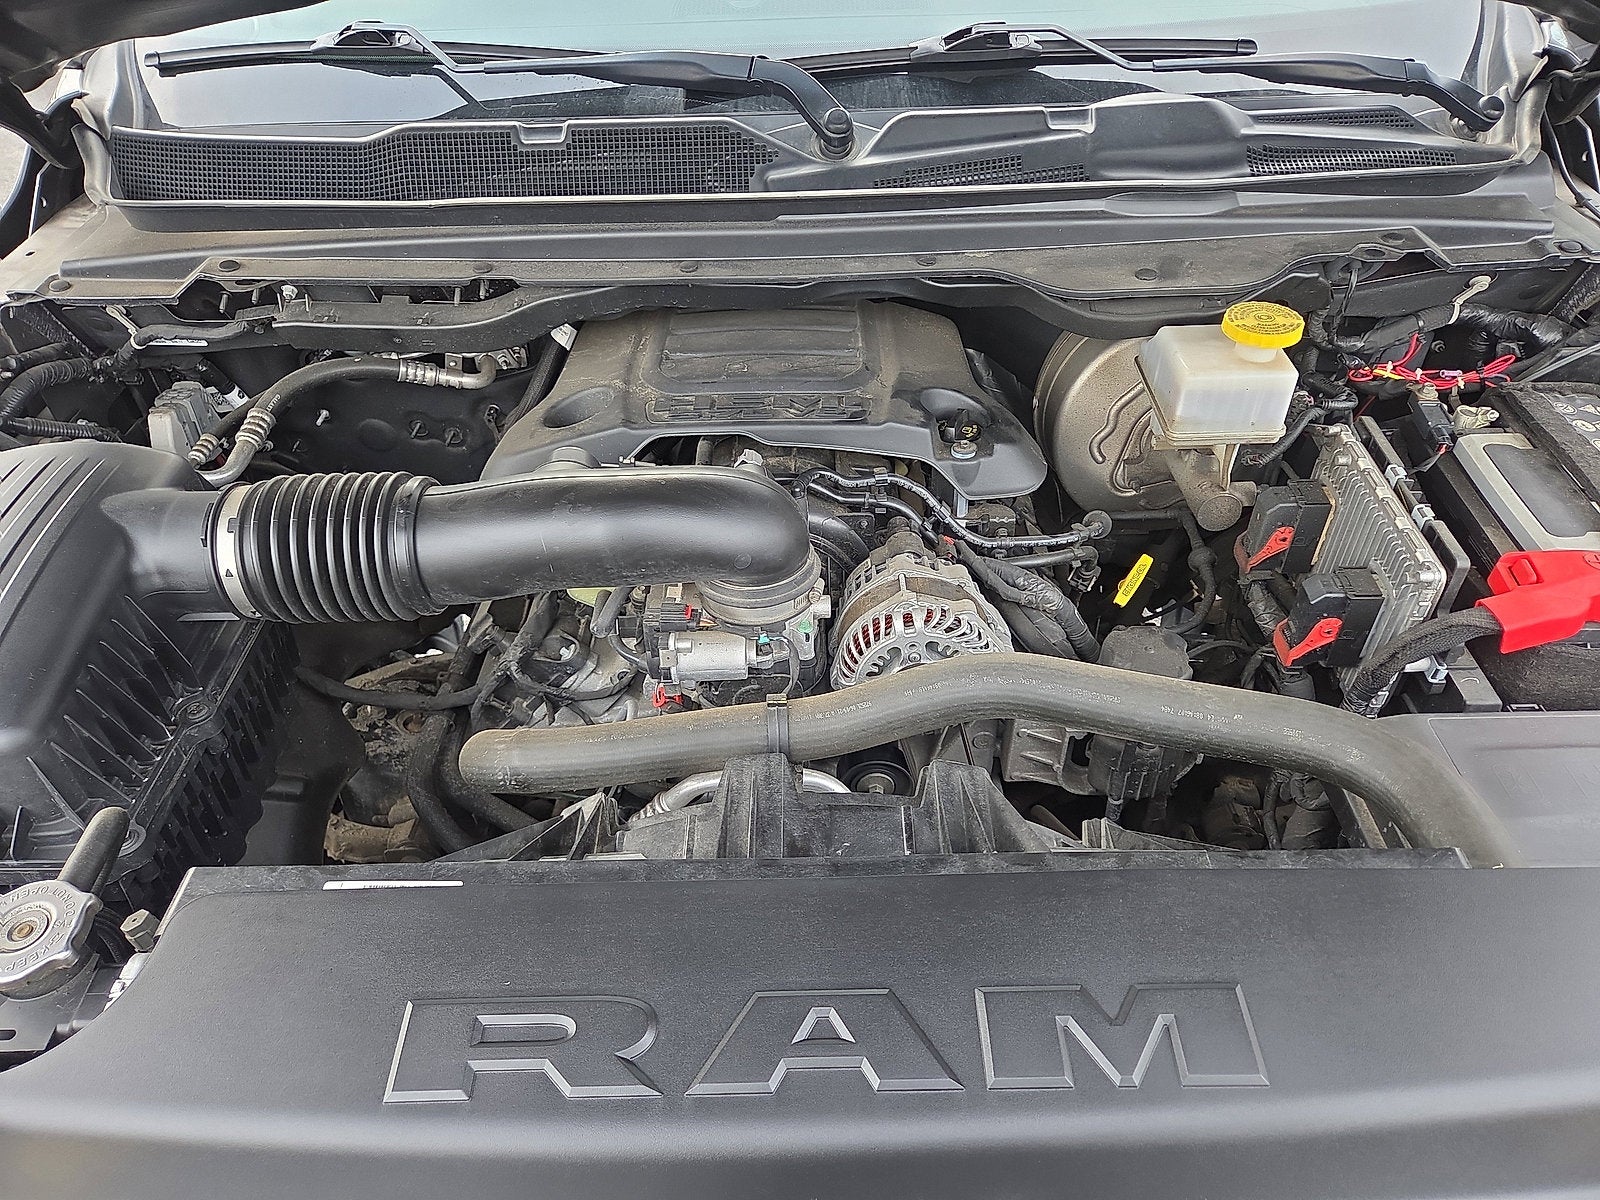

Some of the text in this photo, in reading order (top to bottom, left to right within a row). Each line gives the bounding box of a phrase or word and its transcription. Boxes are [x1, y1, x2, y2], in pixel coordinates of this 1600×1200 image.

[9, 885, 50, 903] OPEN
[4, 944, 51, 973] KEEP
[383, 983, 1272, 1104] RAM
